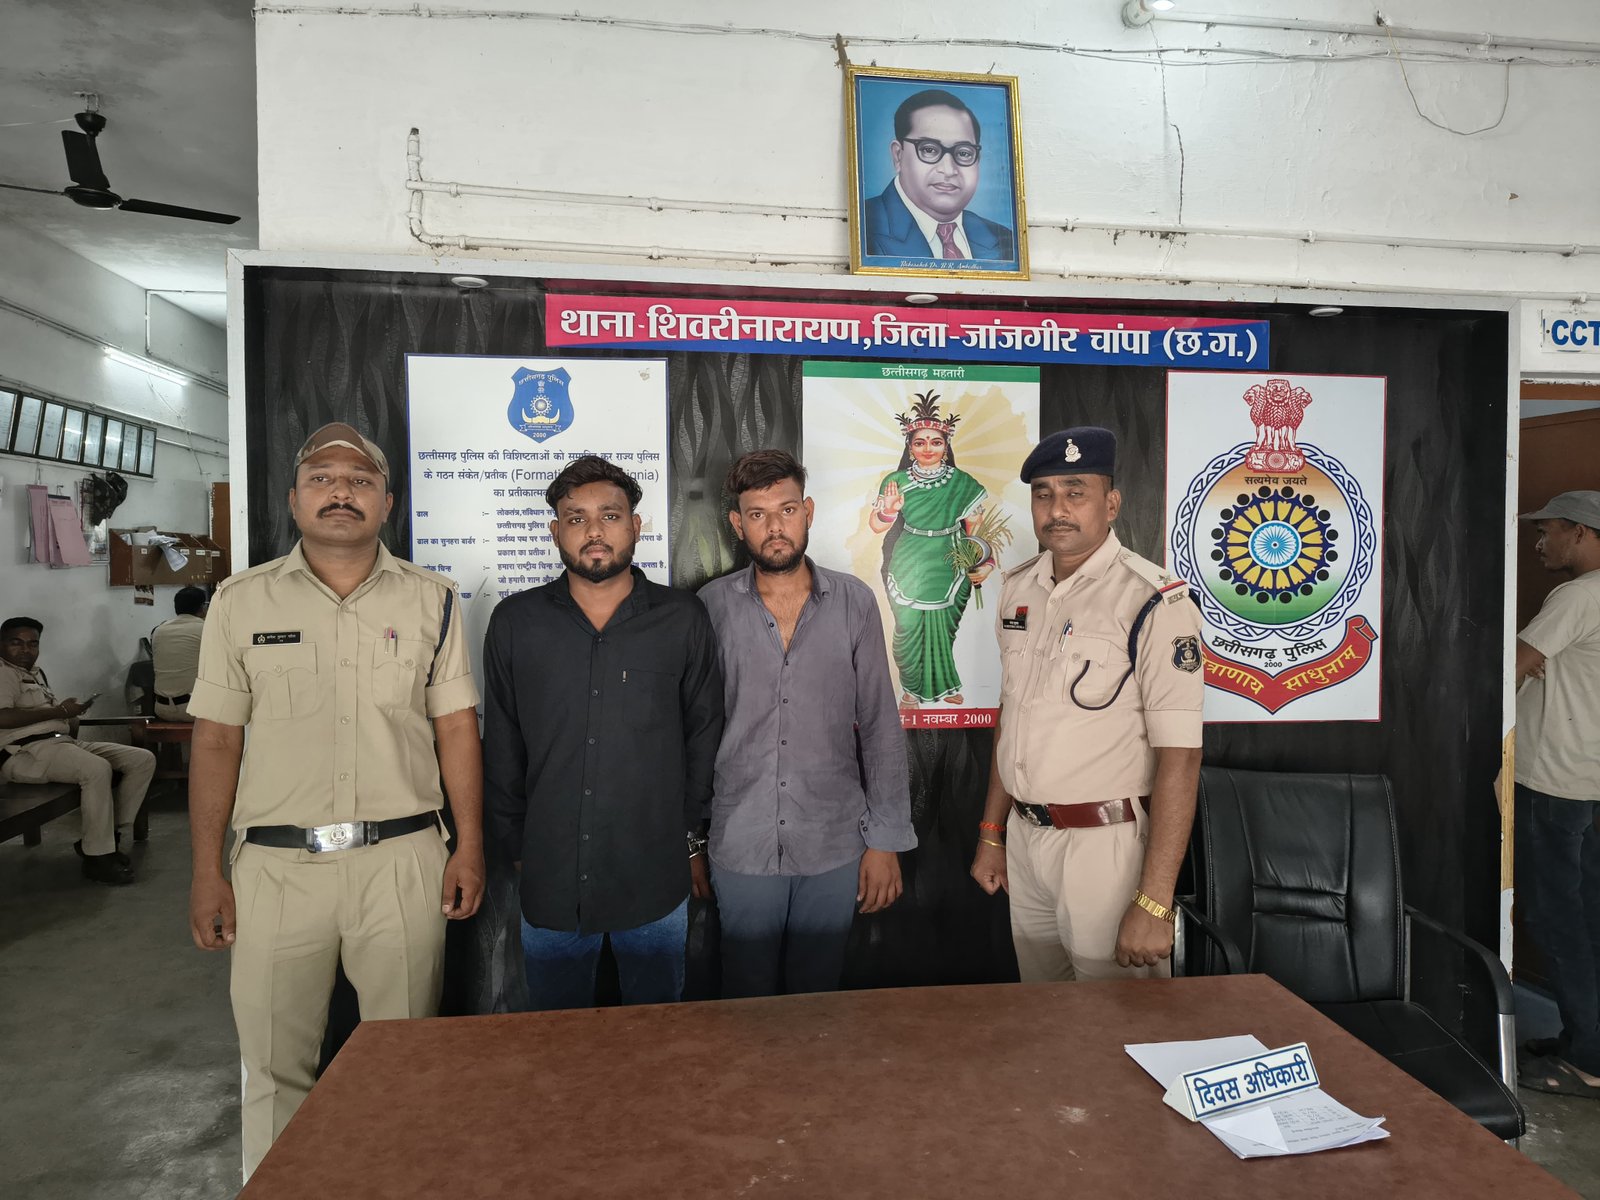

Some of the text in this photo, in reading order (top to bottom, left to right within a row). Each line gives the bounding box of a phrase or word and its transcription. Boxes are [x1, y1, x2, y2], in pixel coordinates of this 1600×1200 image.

[1551, 319, 1600, 346] CCT
[1088, 322, 1151, 355] चांपा
[1162, 326, 1258, 363] (छ.ग.)
[881, 364, 965, 379] छत्तीसगढ़ महतारी
[418, 449, 457, 461] छत्तीसगढ़
[460, 449, 484, 463] पुलिस
[487, 450, 499, 460] की
[503, 449, 550, 461] विशिष्टताओं
[553, 449, 565, 461] को
[600, 452, 613, 461] कर
[616, 452, 634, 461] राज्य
[636, 449, 660, 463] पुलिस
[423, 468, 433, 480] के
[436, 471, 454, 480] गठन
[511, 468, 561, 483] (Formati
[1244, 474, 1308, 485] सत्यमेव जयते
[493, 488, 505, 497] का
[639, 533, 655, 541] रंपरा
[528, 547, 546, 557] प्रतीक
[1211, 635, 1328, 662] छत्तीसगढ़ पुलिस
[923, 714, 958, 725] नवम्बर
[963, 713, 992, 725] 2000
[1193, 1052, 1311, 1109] दिवस अधिकारी
